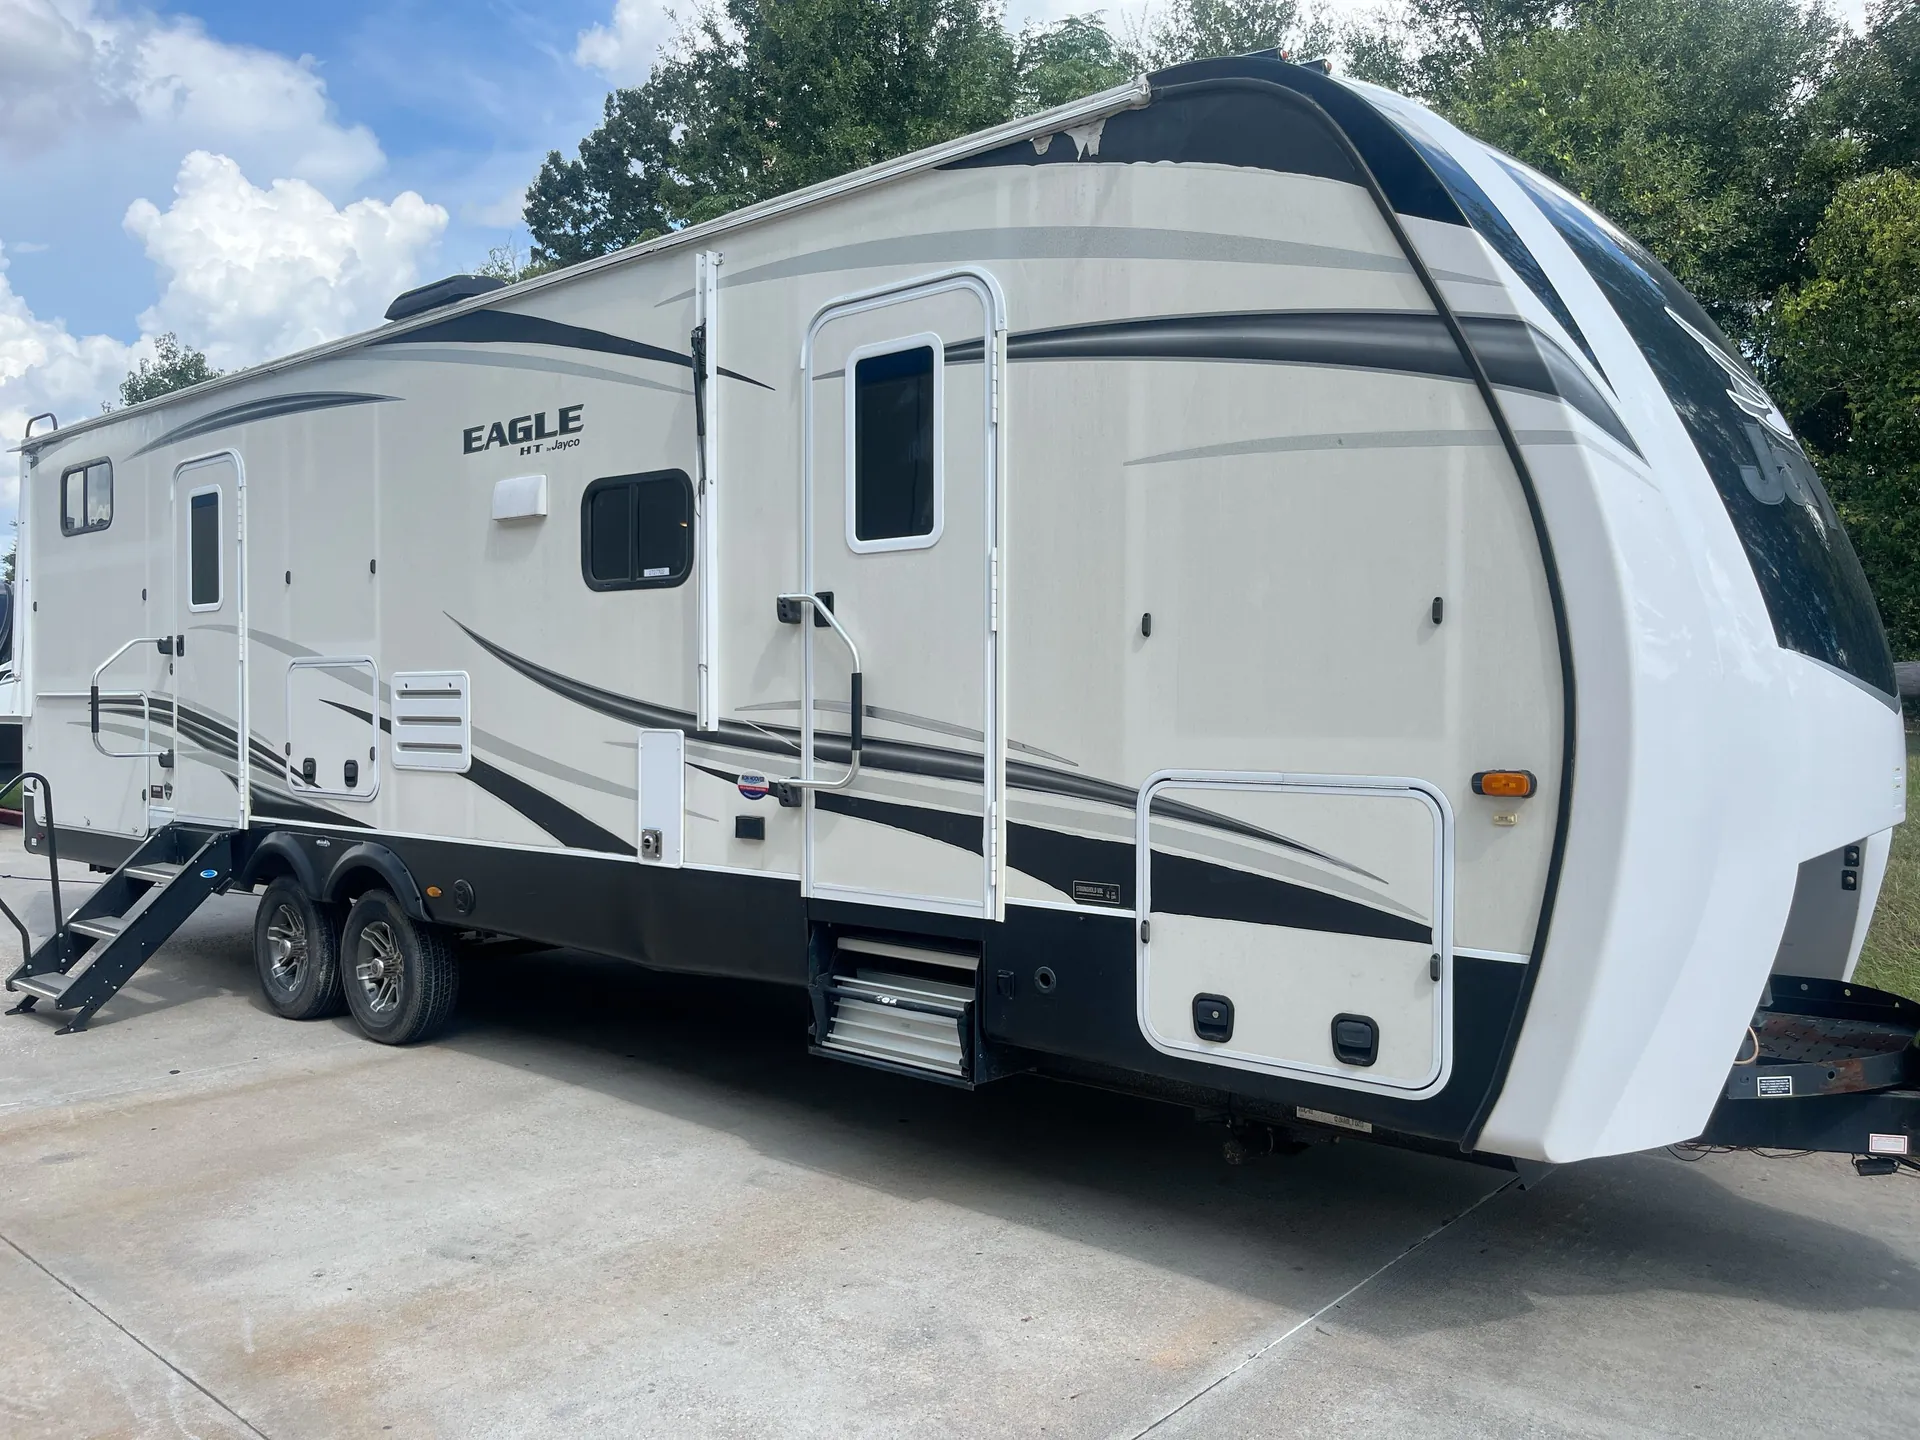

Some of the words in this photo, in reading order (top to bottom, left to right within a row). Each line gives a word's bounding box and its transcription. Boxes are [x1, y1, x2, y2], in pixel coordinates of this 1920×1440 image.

[463, 403, 584, 455] EAGLE
[519, 443, 544, 456] HT
[551, 438, 580, 451] Jayco
